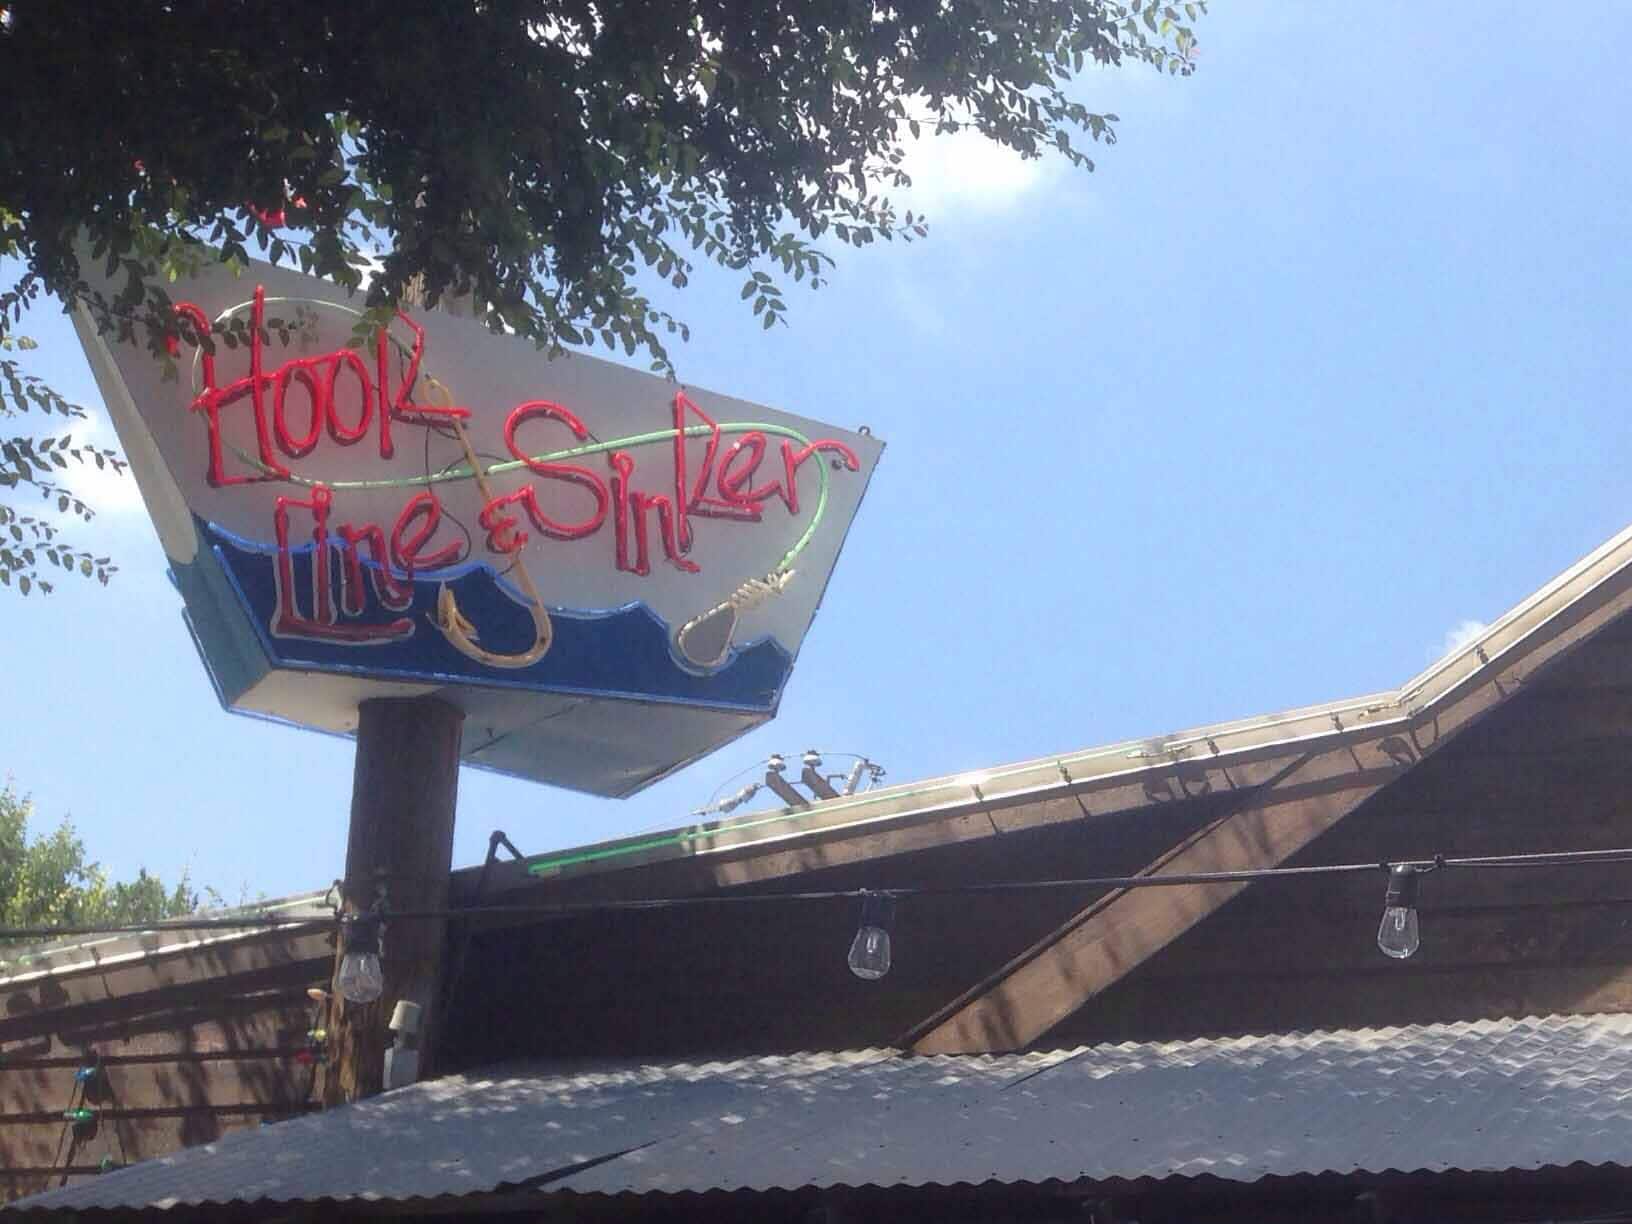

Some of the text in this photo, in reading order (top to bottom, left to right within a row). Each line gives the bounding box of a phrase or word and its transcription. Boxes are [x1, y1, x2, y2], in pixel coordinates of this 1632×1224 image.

[170, 284, 472, 488] Hook
[271, 390, 861, 645] Line & Sinker
